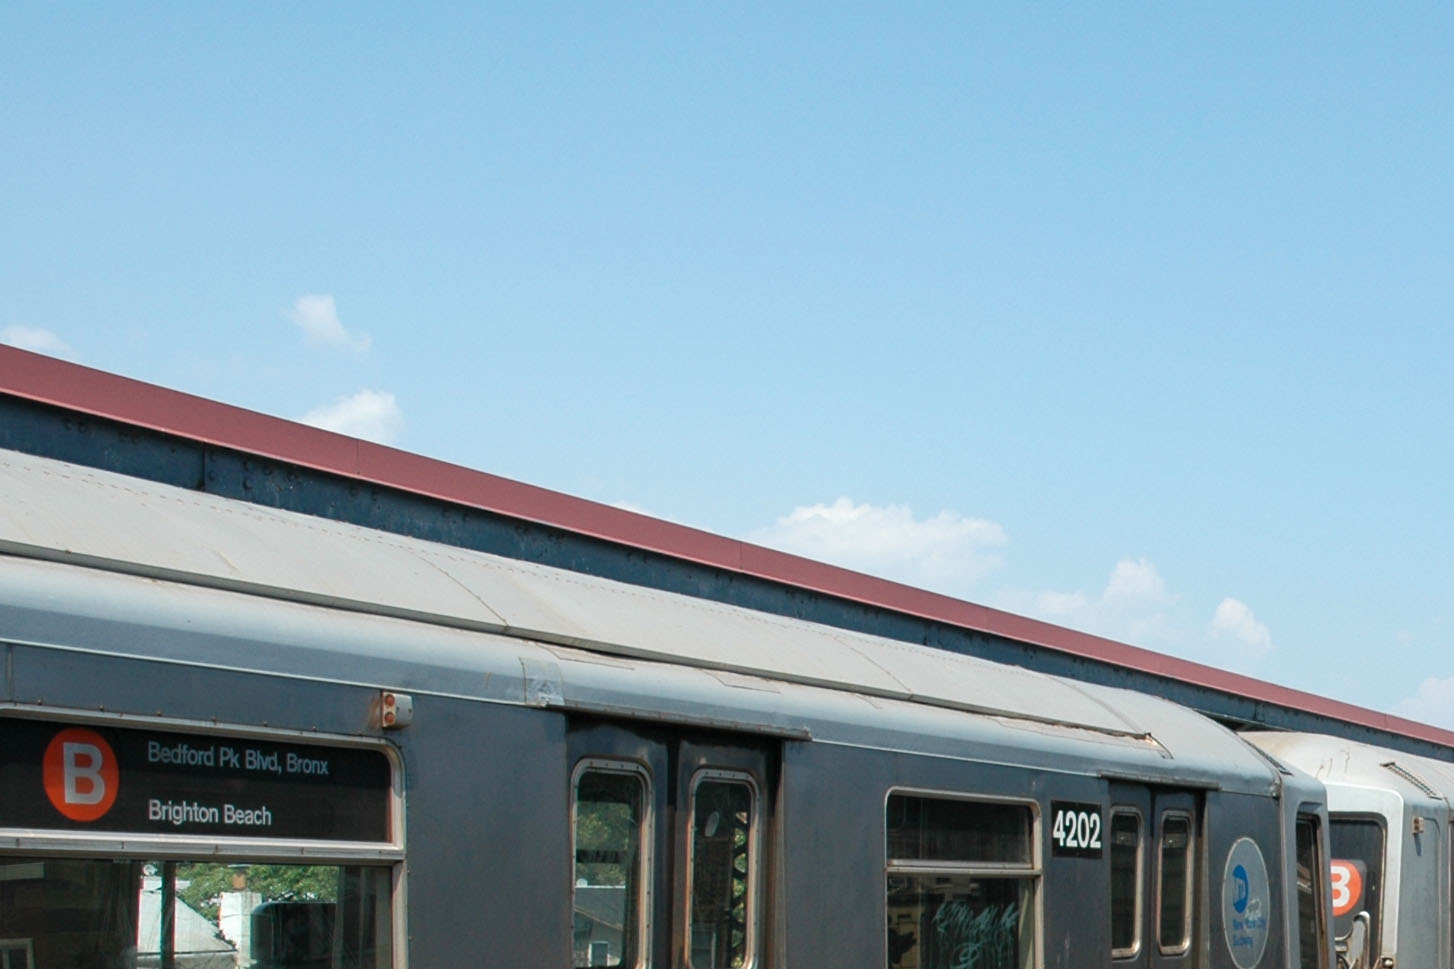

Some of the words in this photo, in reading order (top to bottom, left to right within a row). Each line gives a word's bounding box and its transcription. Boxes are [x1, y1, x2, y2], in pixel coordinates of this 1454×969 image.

[62, 741, 107, 806] B
[147, 740, 215, 768] Bedford
[219, 745, 240, 769] Pk
[244, 749, 283, 775] Blvd,
[286, 752, 330, 776] Bronx
[148, 798, 219, 826] Brighton
[223, 803, 272, 827] Beach
[1052, 809, 1102, 850] 4202
[1330, 865, 1351, 908] B
